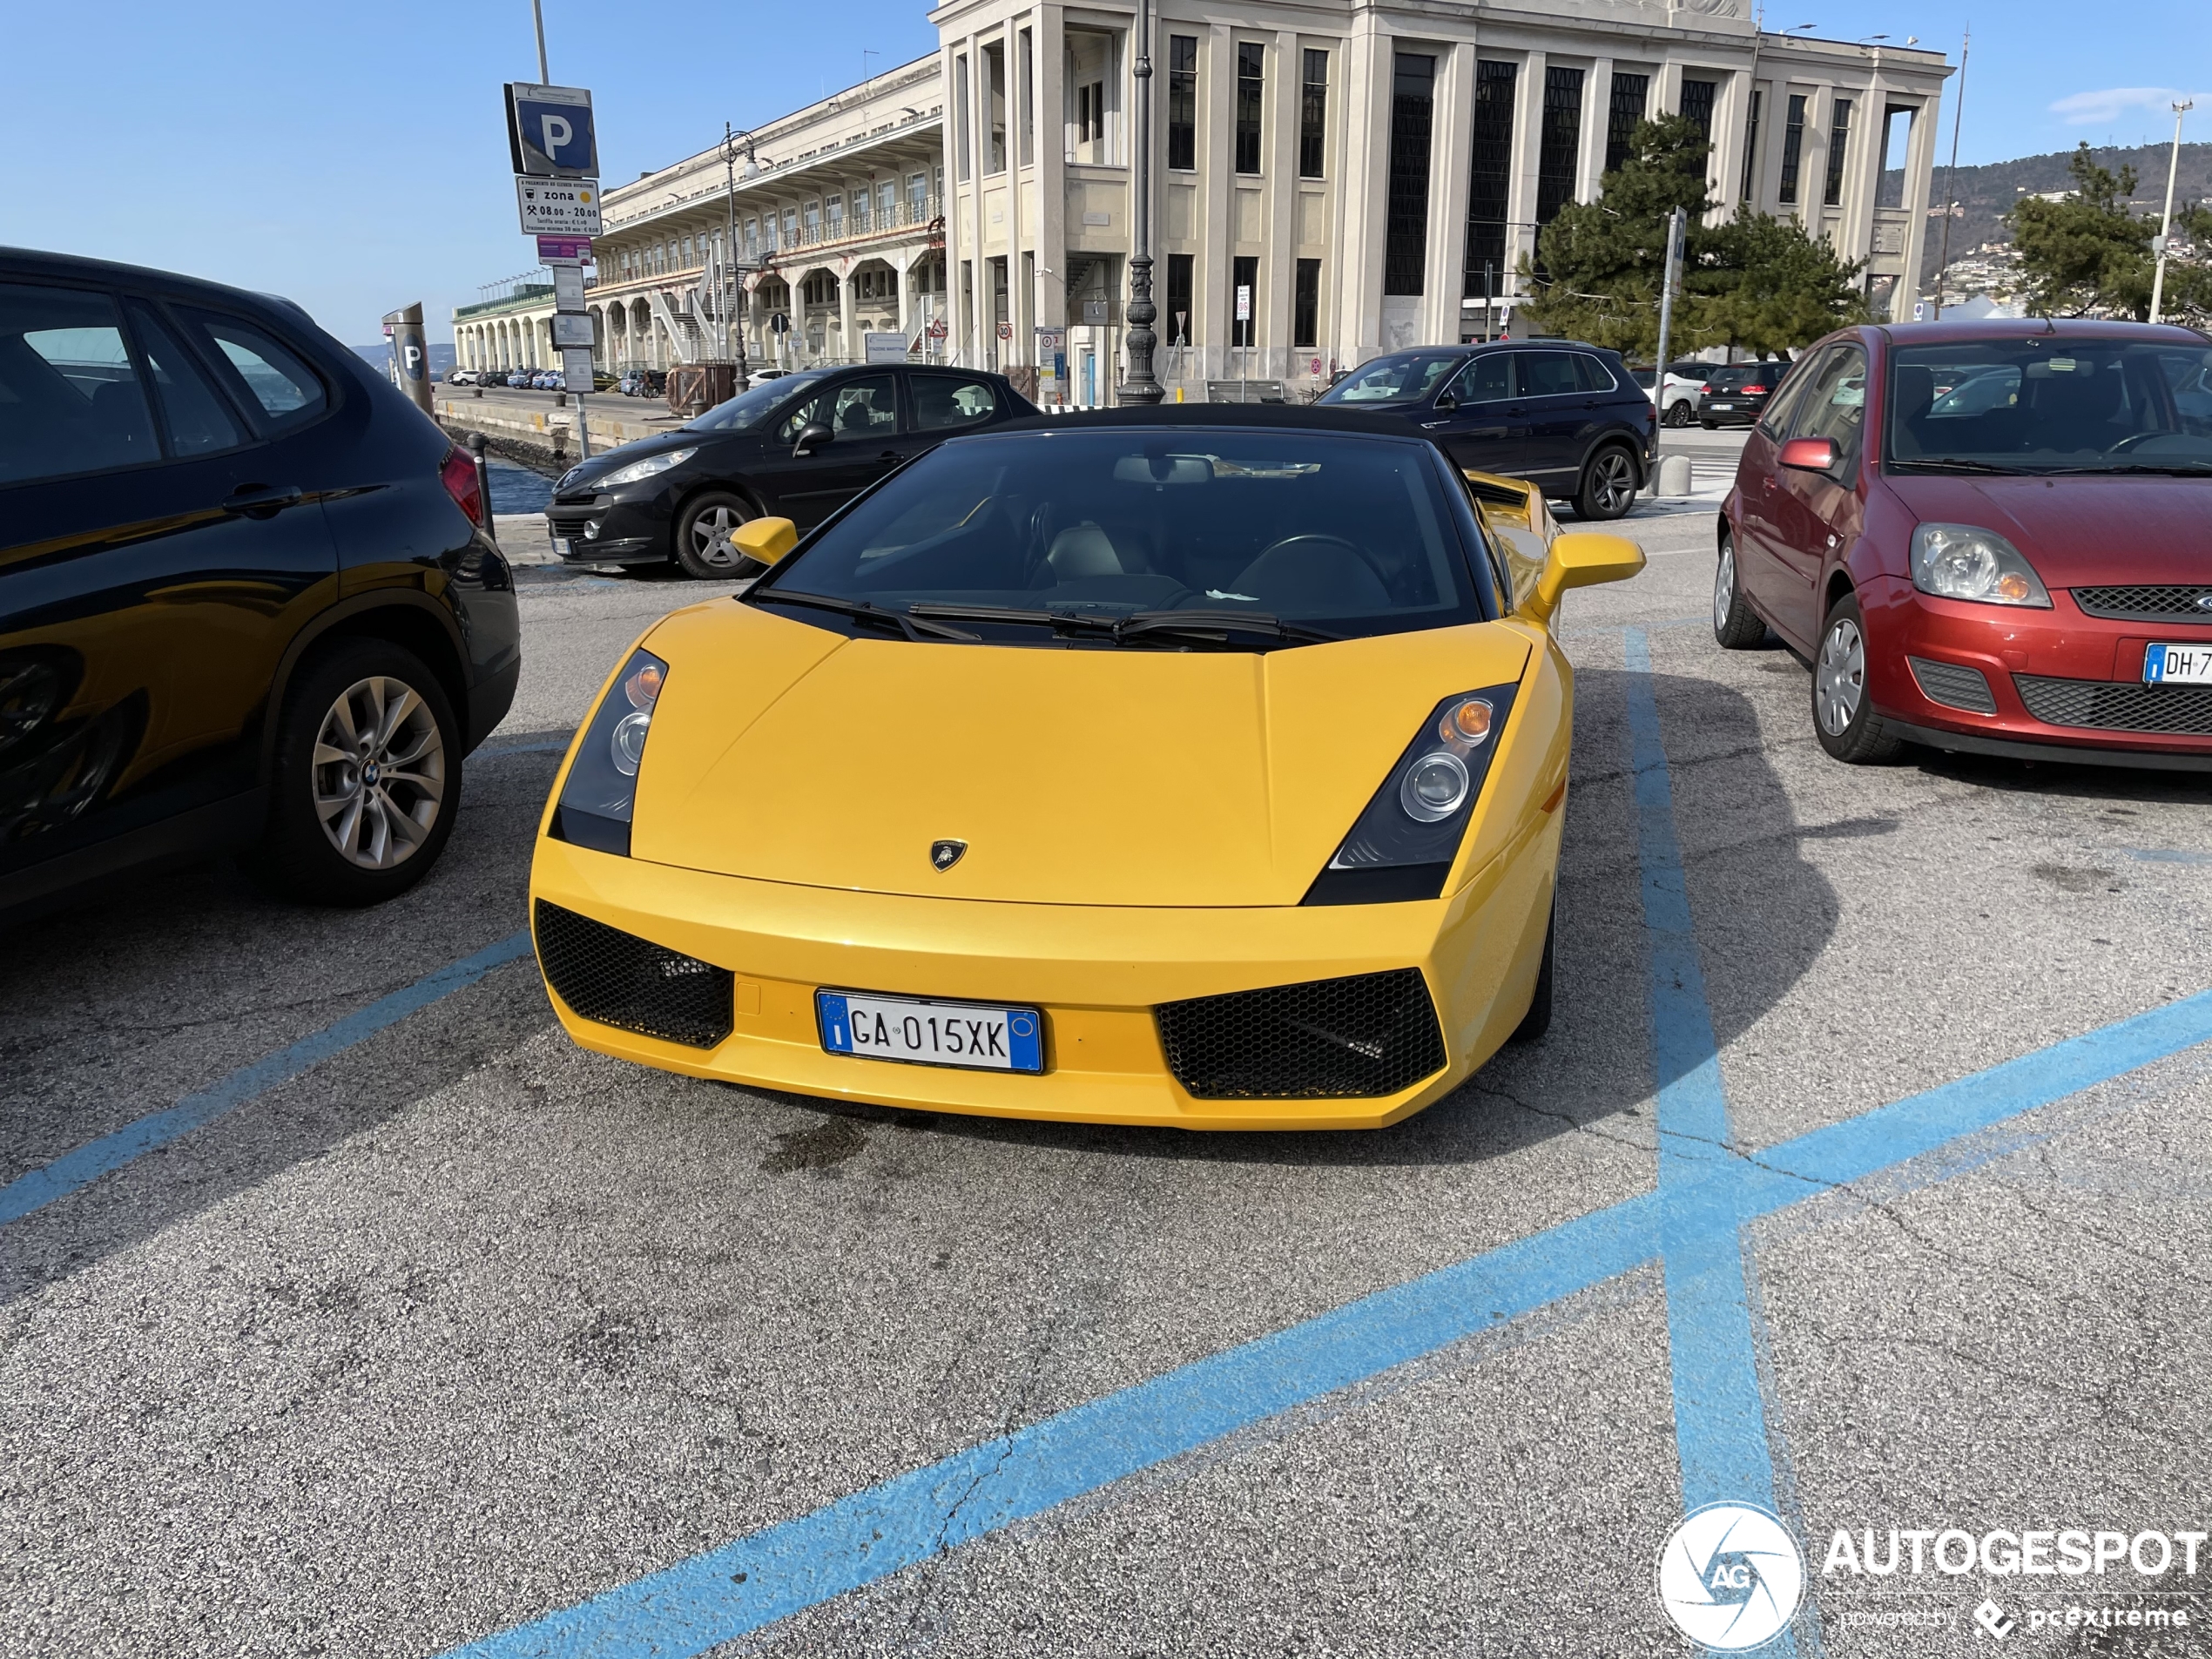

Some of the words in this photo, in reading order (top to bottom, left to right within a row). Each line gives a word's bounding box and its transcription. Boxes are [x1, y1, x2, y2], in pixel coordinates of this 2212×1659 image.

[541, 114, 572, 161] P
[543, 192, 575, 201] zona
[540, 206, 564, 216] 08.00
[574, 207, 597, 218] 20.00
[404, 346, 421, 369] P
[2166, 652, 2192, 675] DH
